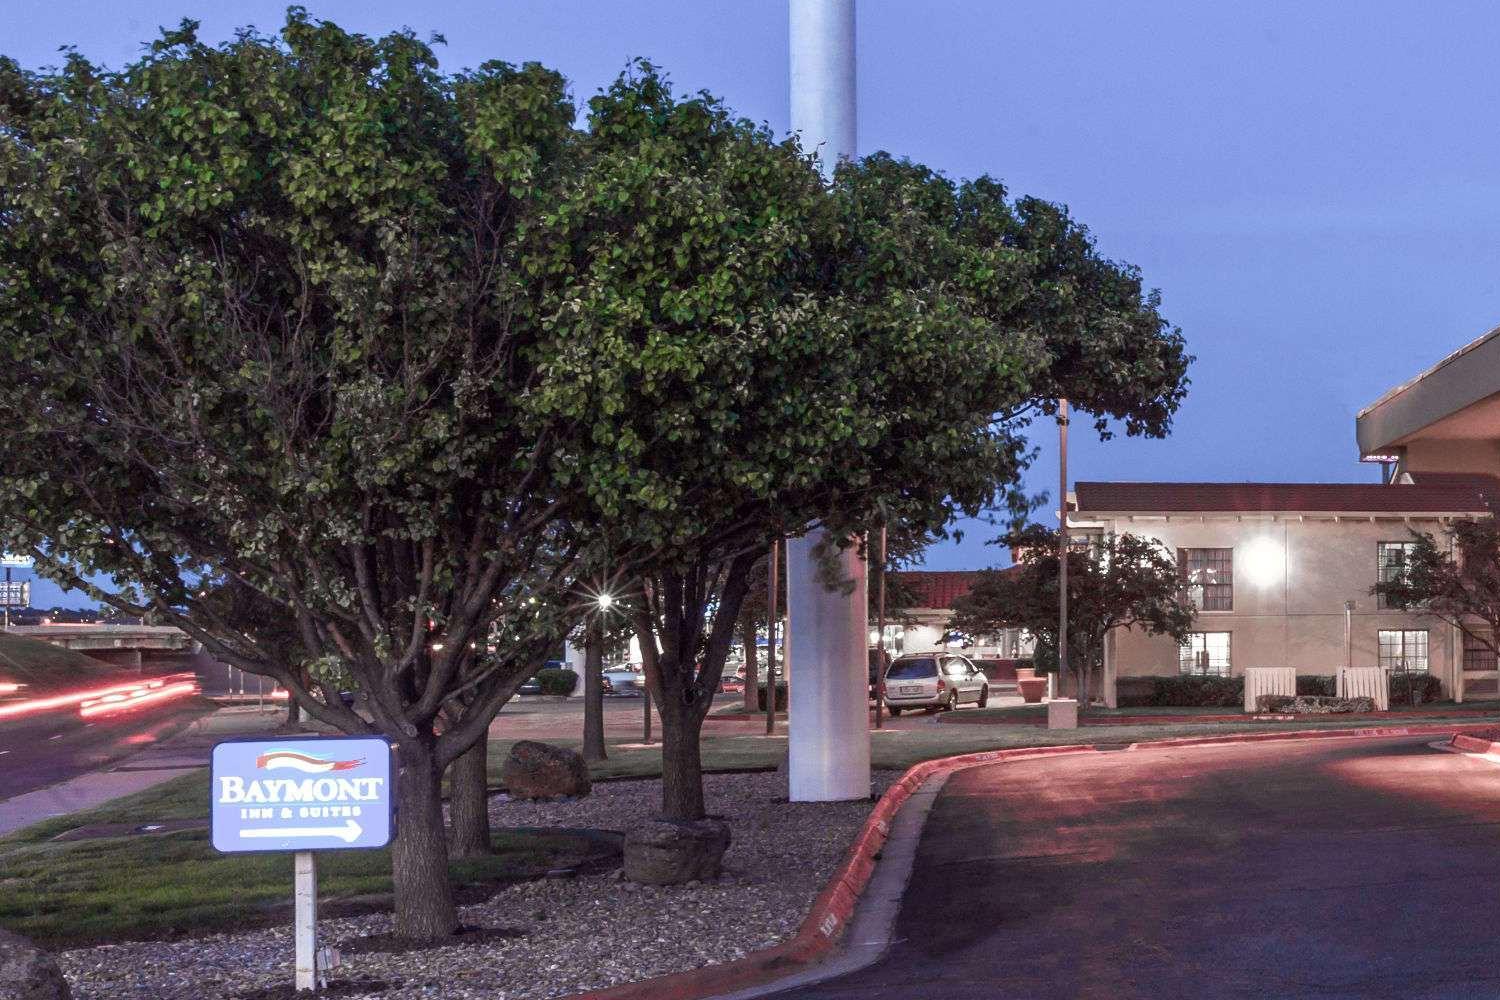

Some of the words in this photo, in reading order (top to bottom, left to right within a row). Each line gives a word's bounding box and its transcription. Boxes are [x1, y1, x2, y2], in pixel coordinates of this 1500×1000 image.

[219, 776, 383, 802] BAYMONT
[240, 807, 274, 819] INN
[281, 807, 293, 819] &
[300, 806, 362, 818] SUITES
